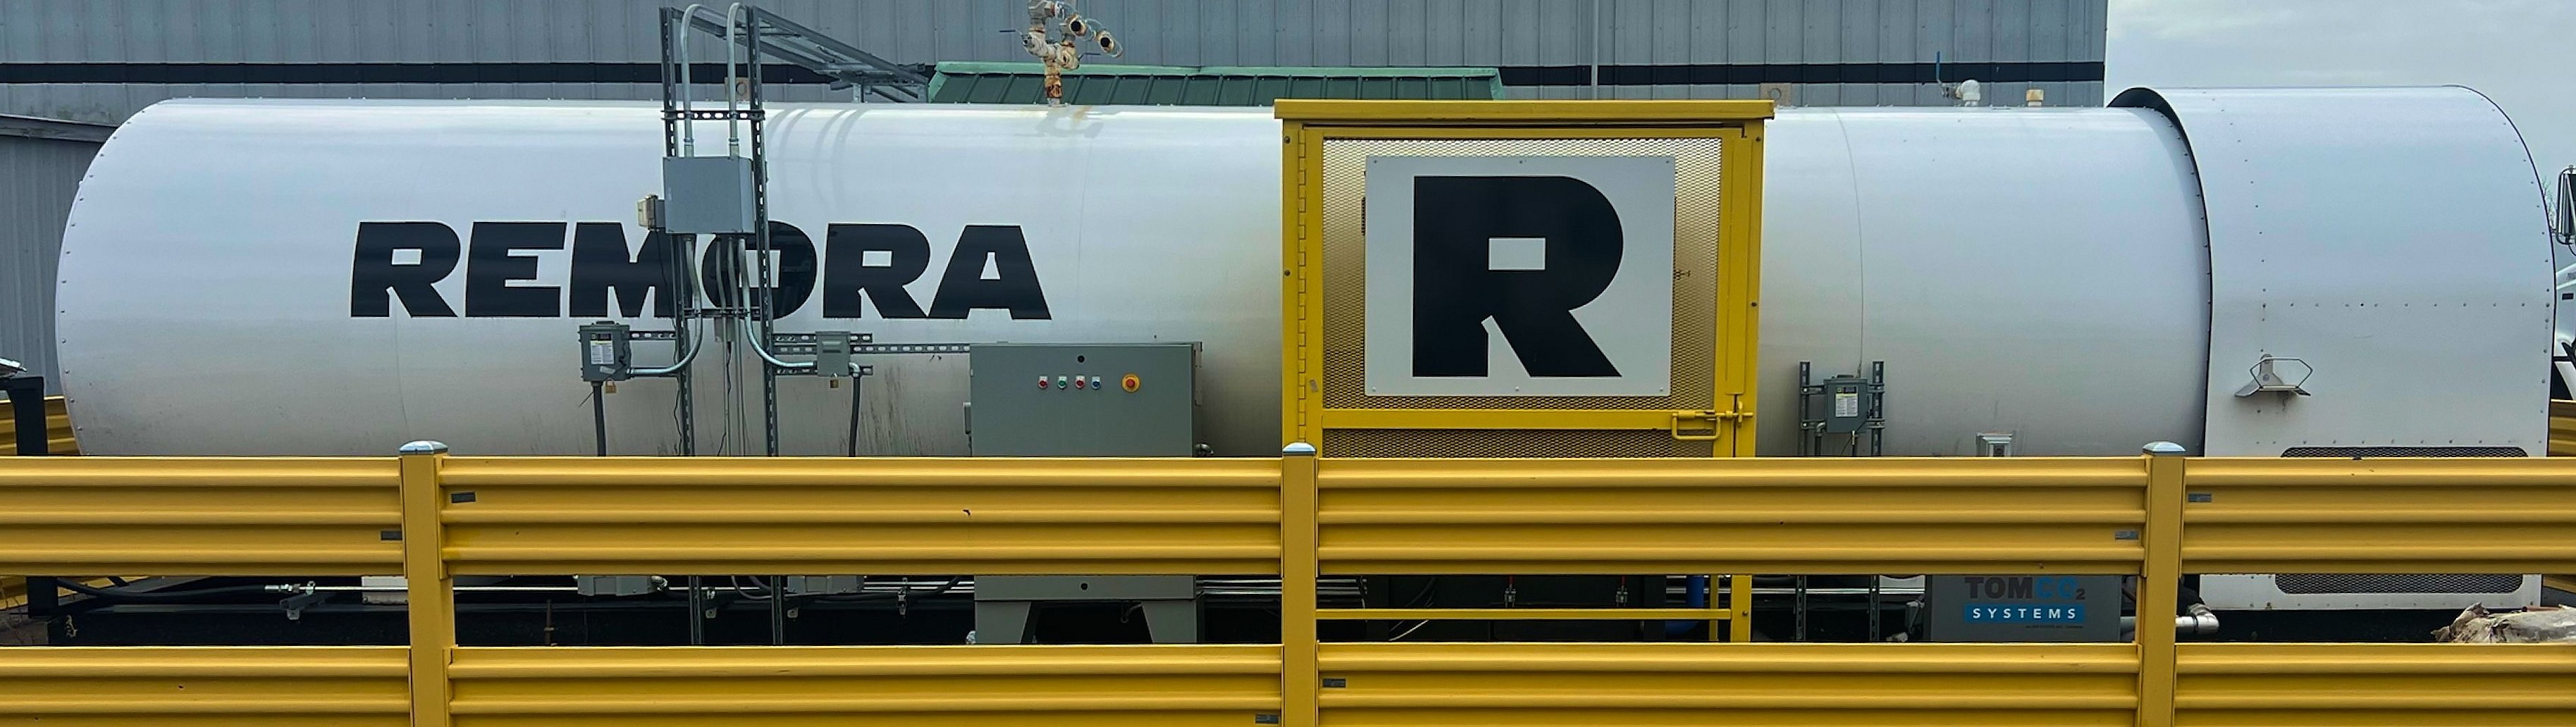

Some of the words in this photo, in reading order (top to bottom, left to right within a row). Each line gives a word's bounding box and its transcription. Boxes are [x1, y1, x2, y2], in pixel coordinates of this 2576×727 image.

[350, 220, 1052, 321] REMORA
[1412, 175, 1624, 378] R
[1973, 608, 2076, 619] SYSTEMS
